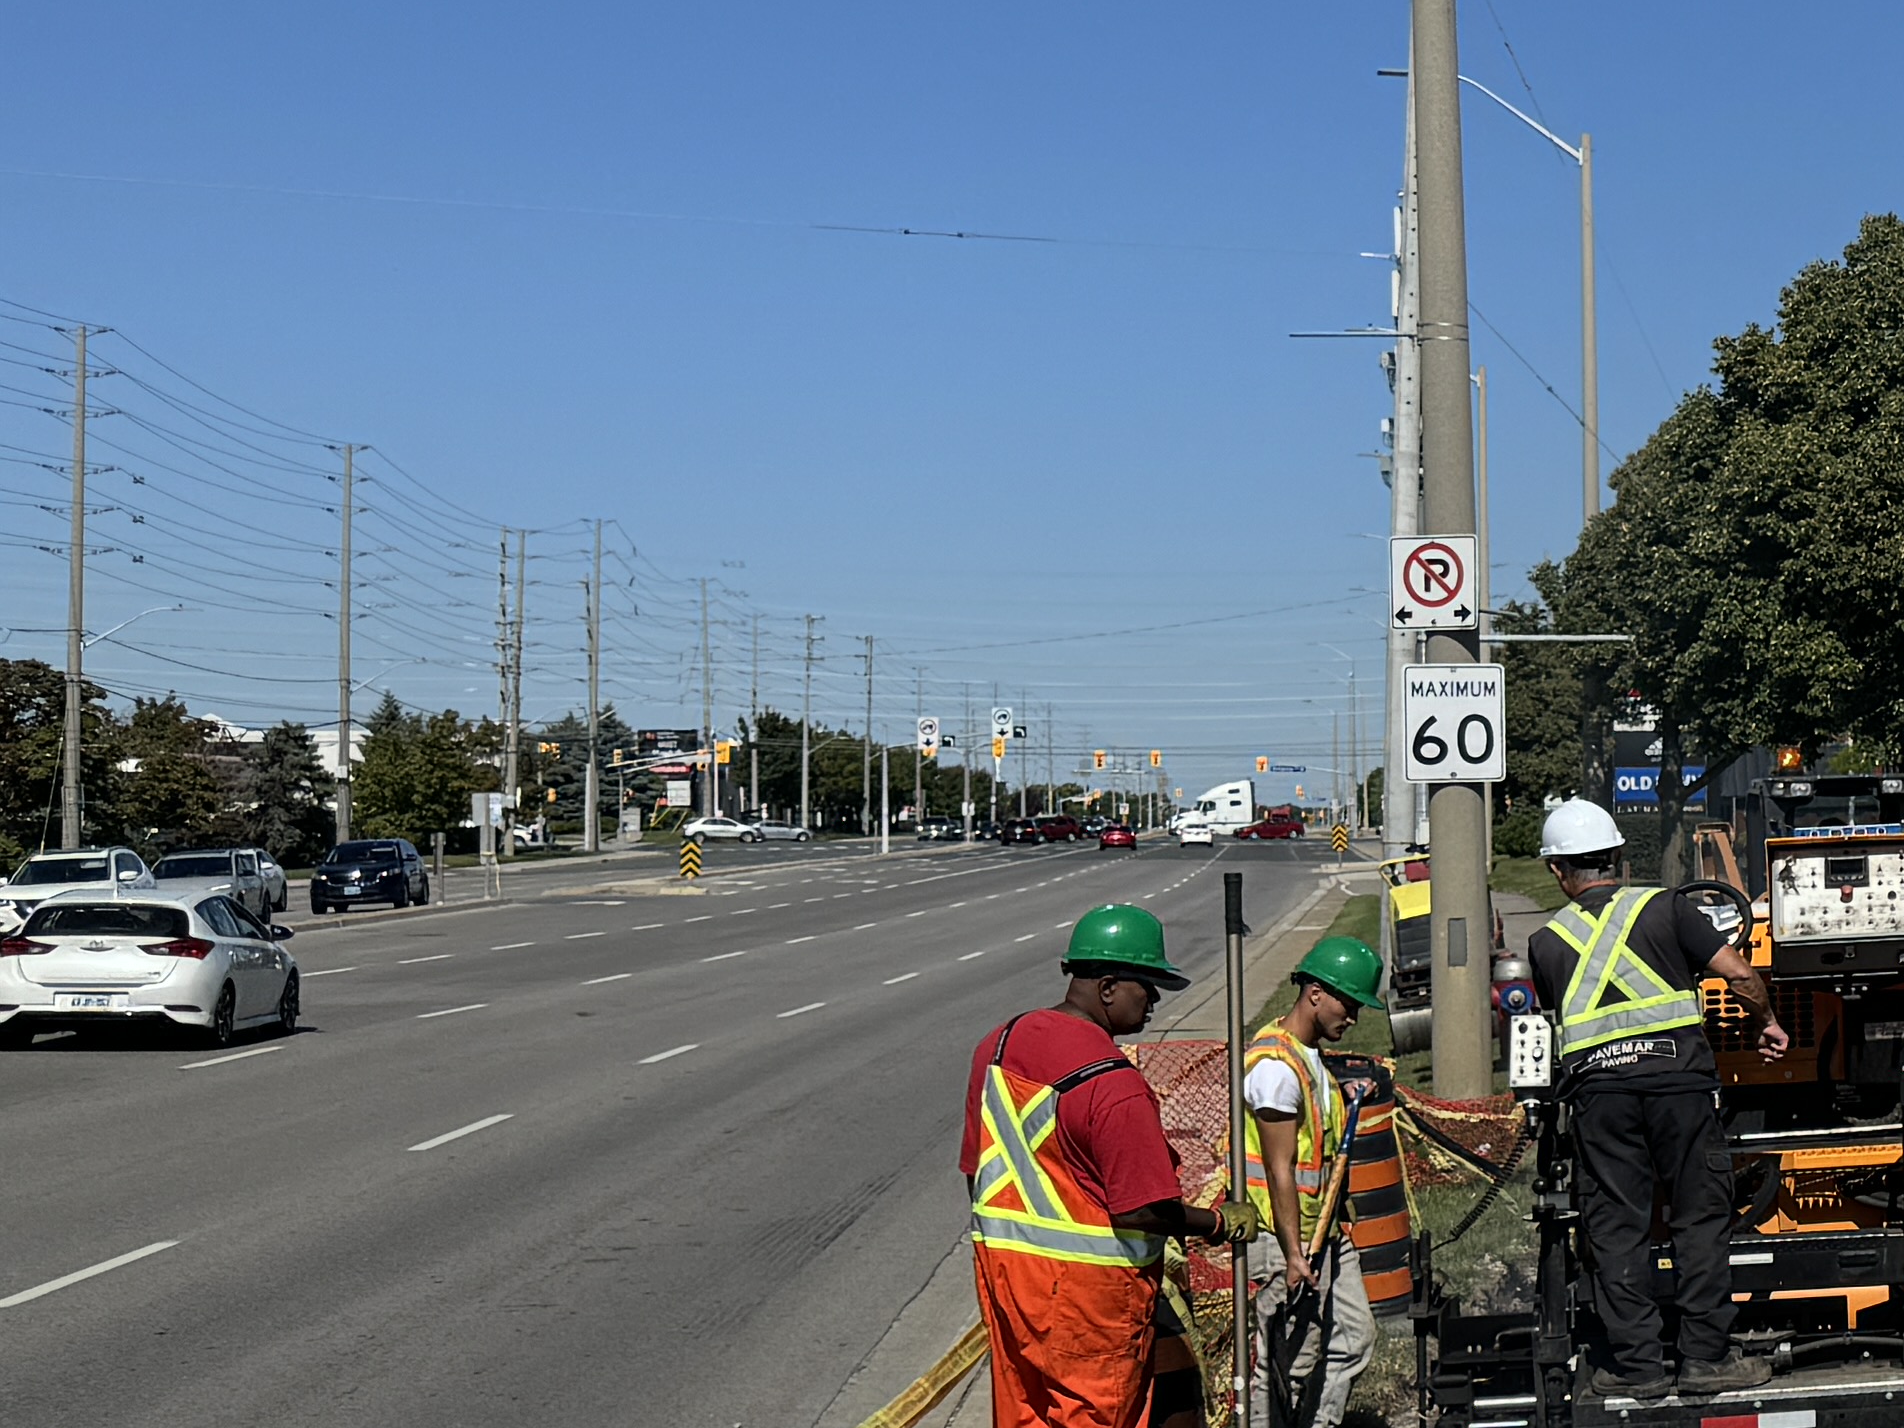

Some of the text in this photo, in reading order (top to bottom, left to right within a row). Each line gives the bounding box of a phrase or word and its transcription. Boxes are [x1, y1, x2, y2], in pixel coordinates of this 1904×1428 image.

[1411, 681, 1496, 697] MAXIMUM
[1412, 714, 1494, 765] 60
[1617, 776, 1652, 791] OLD
